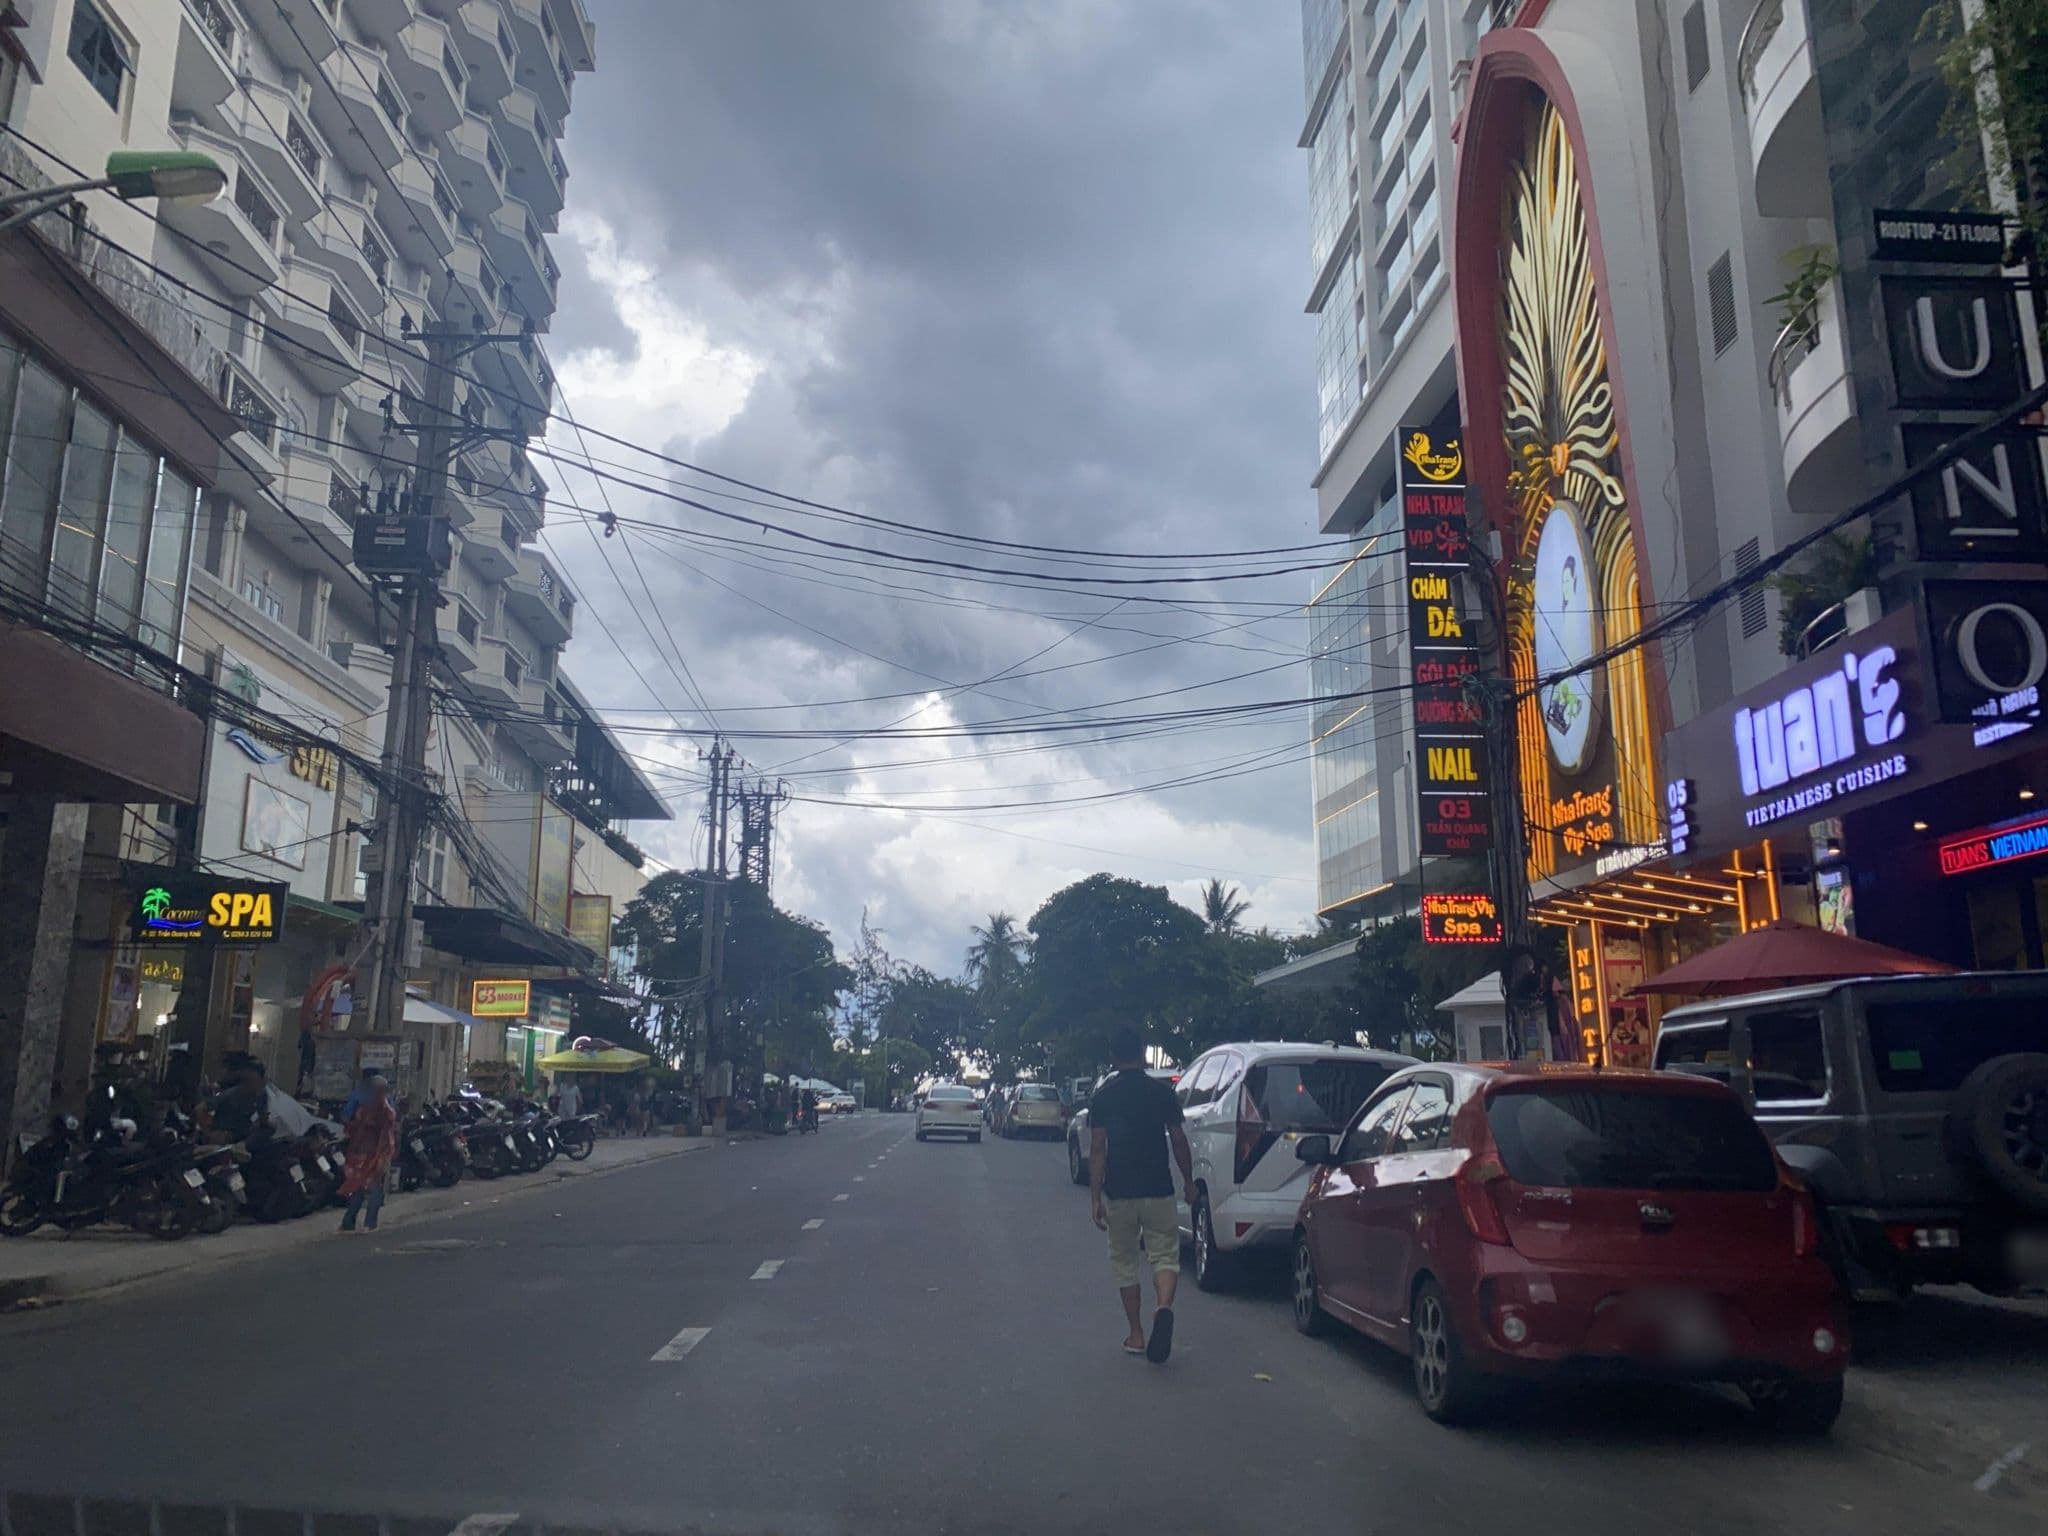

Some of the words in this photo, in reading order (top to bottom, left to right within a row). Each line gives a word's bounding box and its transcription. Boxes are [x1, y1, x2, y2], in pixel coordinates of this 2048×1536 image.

[1411, 573, 1448, 600] CHĂM
[1427, 747, 1478, 781] NAIL
[1667, 779, 1688, 809] 05
[1745, 782, 1833, 827] VIETNAMESE
[1836, 754, 1907, 795] CUISINE
[1439, 799, 1471, 819] 03
[208, 892, 273, 927] SPA
[1443, 917, 1482, 937] Spa
